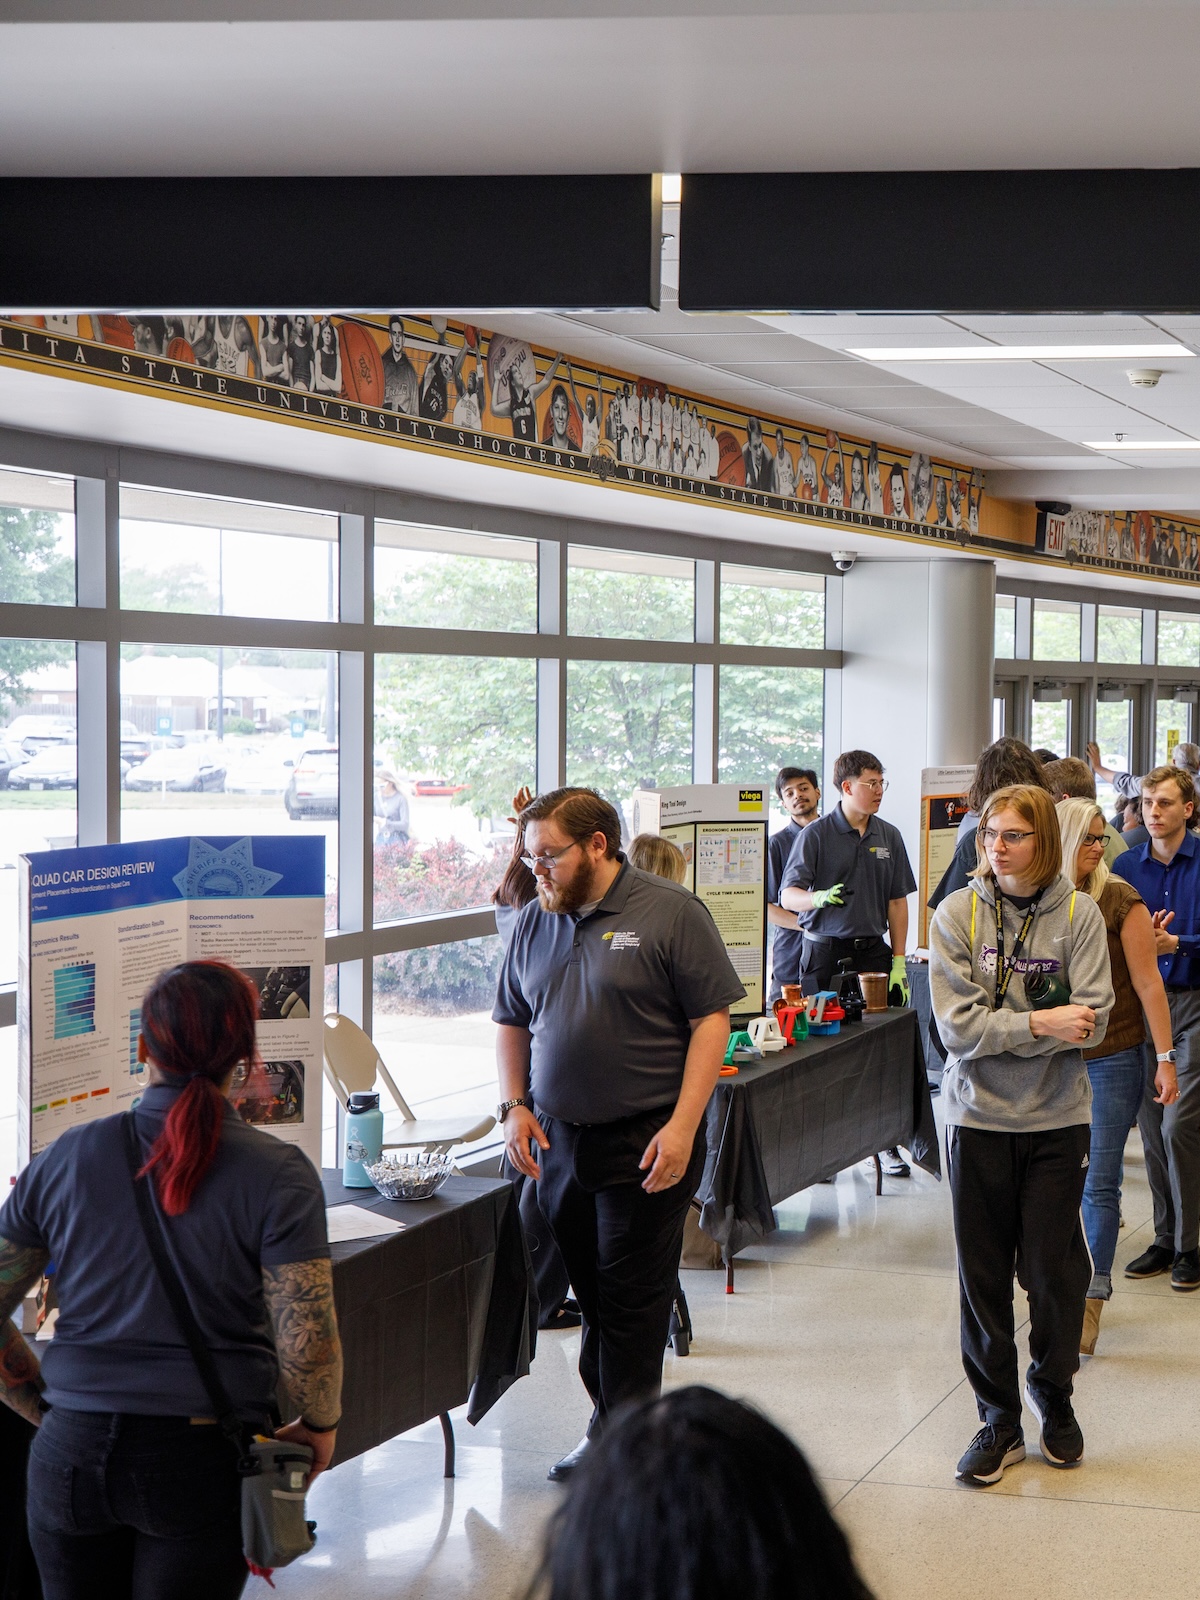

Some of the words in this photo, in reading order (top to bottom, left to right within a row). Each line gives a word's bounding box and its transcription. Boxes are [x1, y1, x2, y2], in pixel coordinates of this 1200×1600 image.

[122, 356, 228, 394] STATE
[257, 386, 436, 440] UNIVERSITY
[458, 432, 576, 468] SHOCKERS
[520, 419, 527, 434] 6
[626, 468, 706, 494] WICHITA
[720, 490, 768, 507] STATE
[782, 496, 873, 526] UNIVERSITY
[883, 518, 949, 540] SHOCKERS
[1048, 519, 1066, 551] EXIT
[740, 790, 761, 800] viega
[63, 870, 85, 883] CAR
[87, 866, 120, 881] DESIGN
[122, 861, 155, 876] REVIEW
[186, 858, 227, 885] SHERIFF'S
[230, 860, 254, 884] OFFICE
[32, 937, 58, 947] rgonomics
